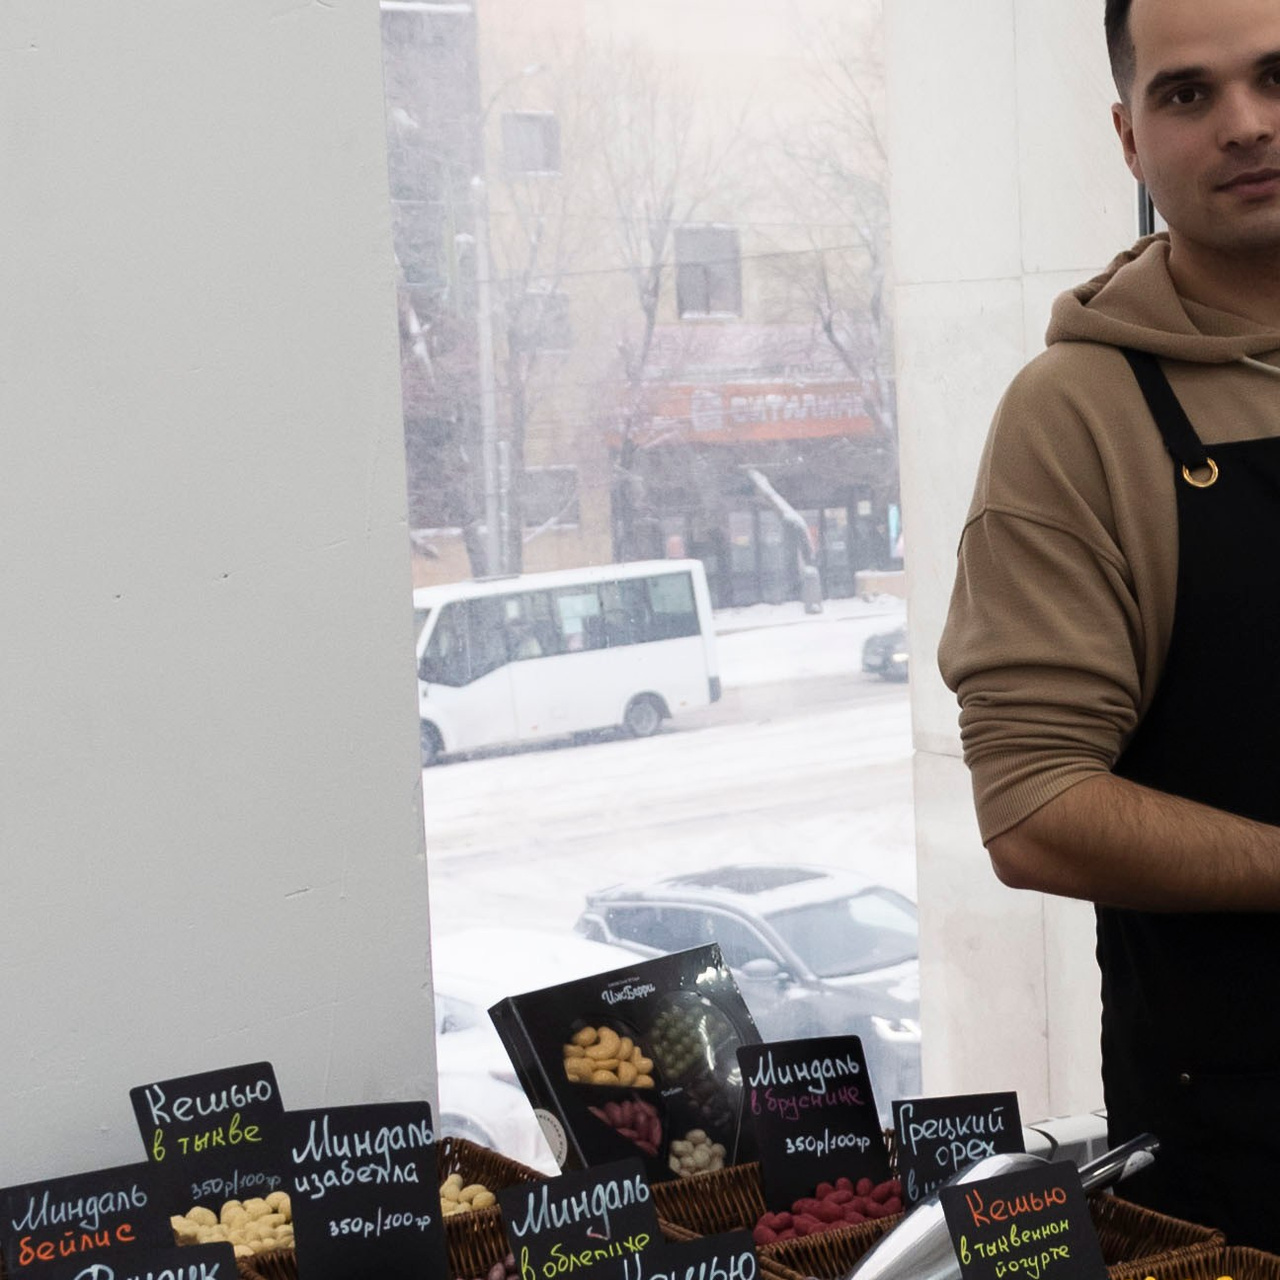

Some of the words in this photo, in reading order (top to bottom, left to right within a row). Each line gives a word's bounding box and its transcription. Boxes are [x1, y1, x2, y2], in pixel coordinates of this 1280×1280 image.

[749, 1051, 860, 1095] Миндаль
[145, 1080, 272, 1126] Кешью
[750, 1088, 761, 1116] в
[153, 1128, 166, 1161] в
[178, 1112, 262, 1155] тыкве
[292, 1114, 434, 1171] Миндаль
[899, 1103, 1005, 1156] Грецкий
[935, 1138, 996, 1171] орех
[11, 1184, 148, 1231] Миндаль
[512, 1174, 650, 1241] Миндаль
[965, 1187, 1067, 1228] Кешью
[18, 1223, 136, 1266] бейлис
[960, 1235, 972, 1265] в
[995, 1245, 1071, 1280] йогурте
